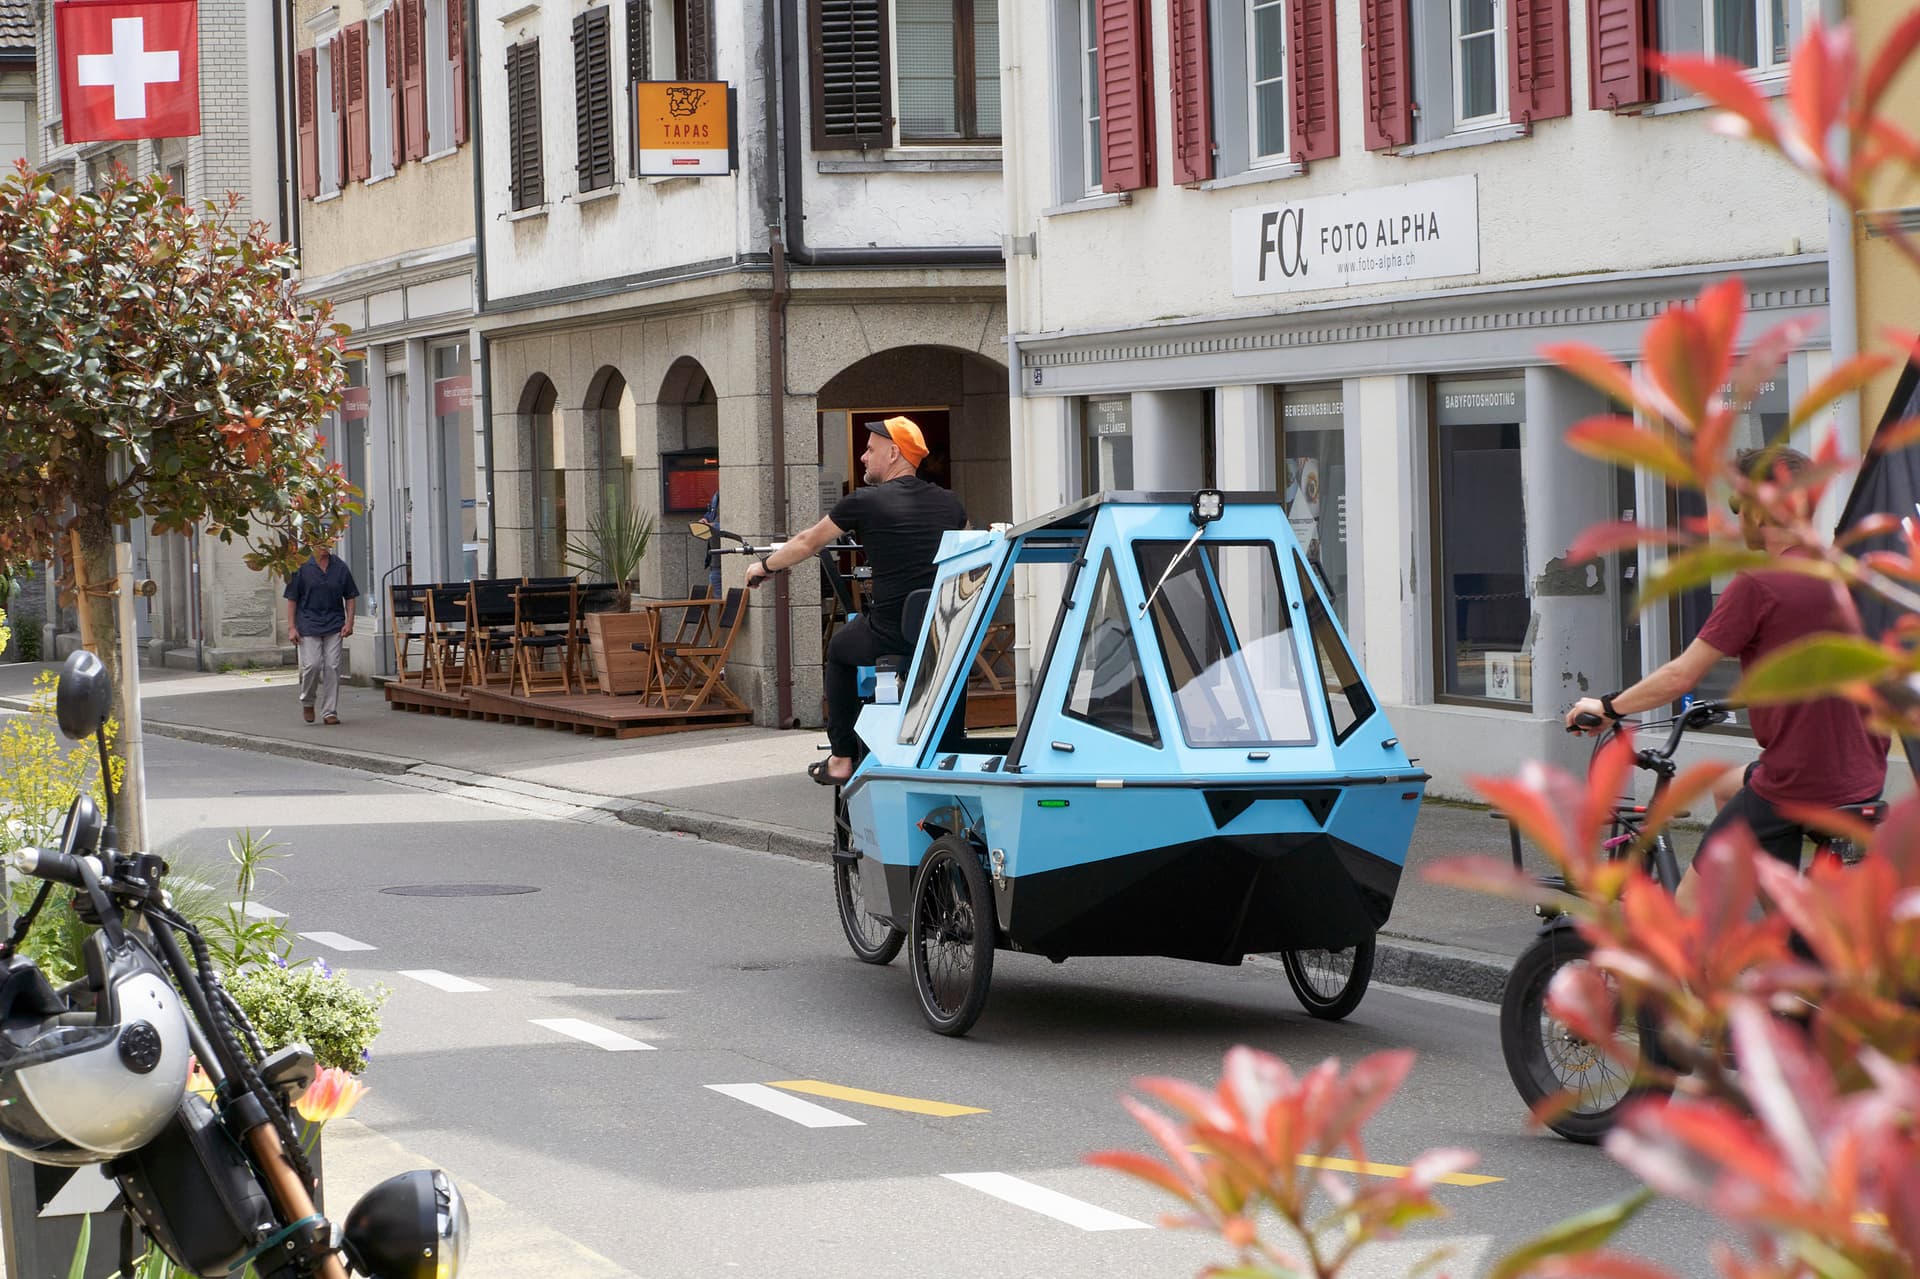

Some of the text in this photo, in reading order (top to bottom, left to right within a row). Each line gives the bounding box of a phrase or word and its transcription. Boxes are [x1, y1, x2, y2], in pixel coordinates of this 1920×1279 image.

[664, 125, 709, 138] TAPAS
[1320, 211, 1440, 255] FOTO ALPHA
[1336, 250, 1416, 274] www.foto-alpha.ch
[1285, 402, 1345, 416] BEWERBUNGSBILDER
[1445, 392, 1515, 409] BABYFOTOSHOOTING
